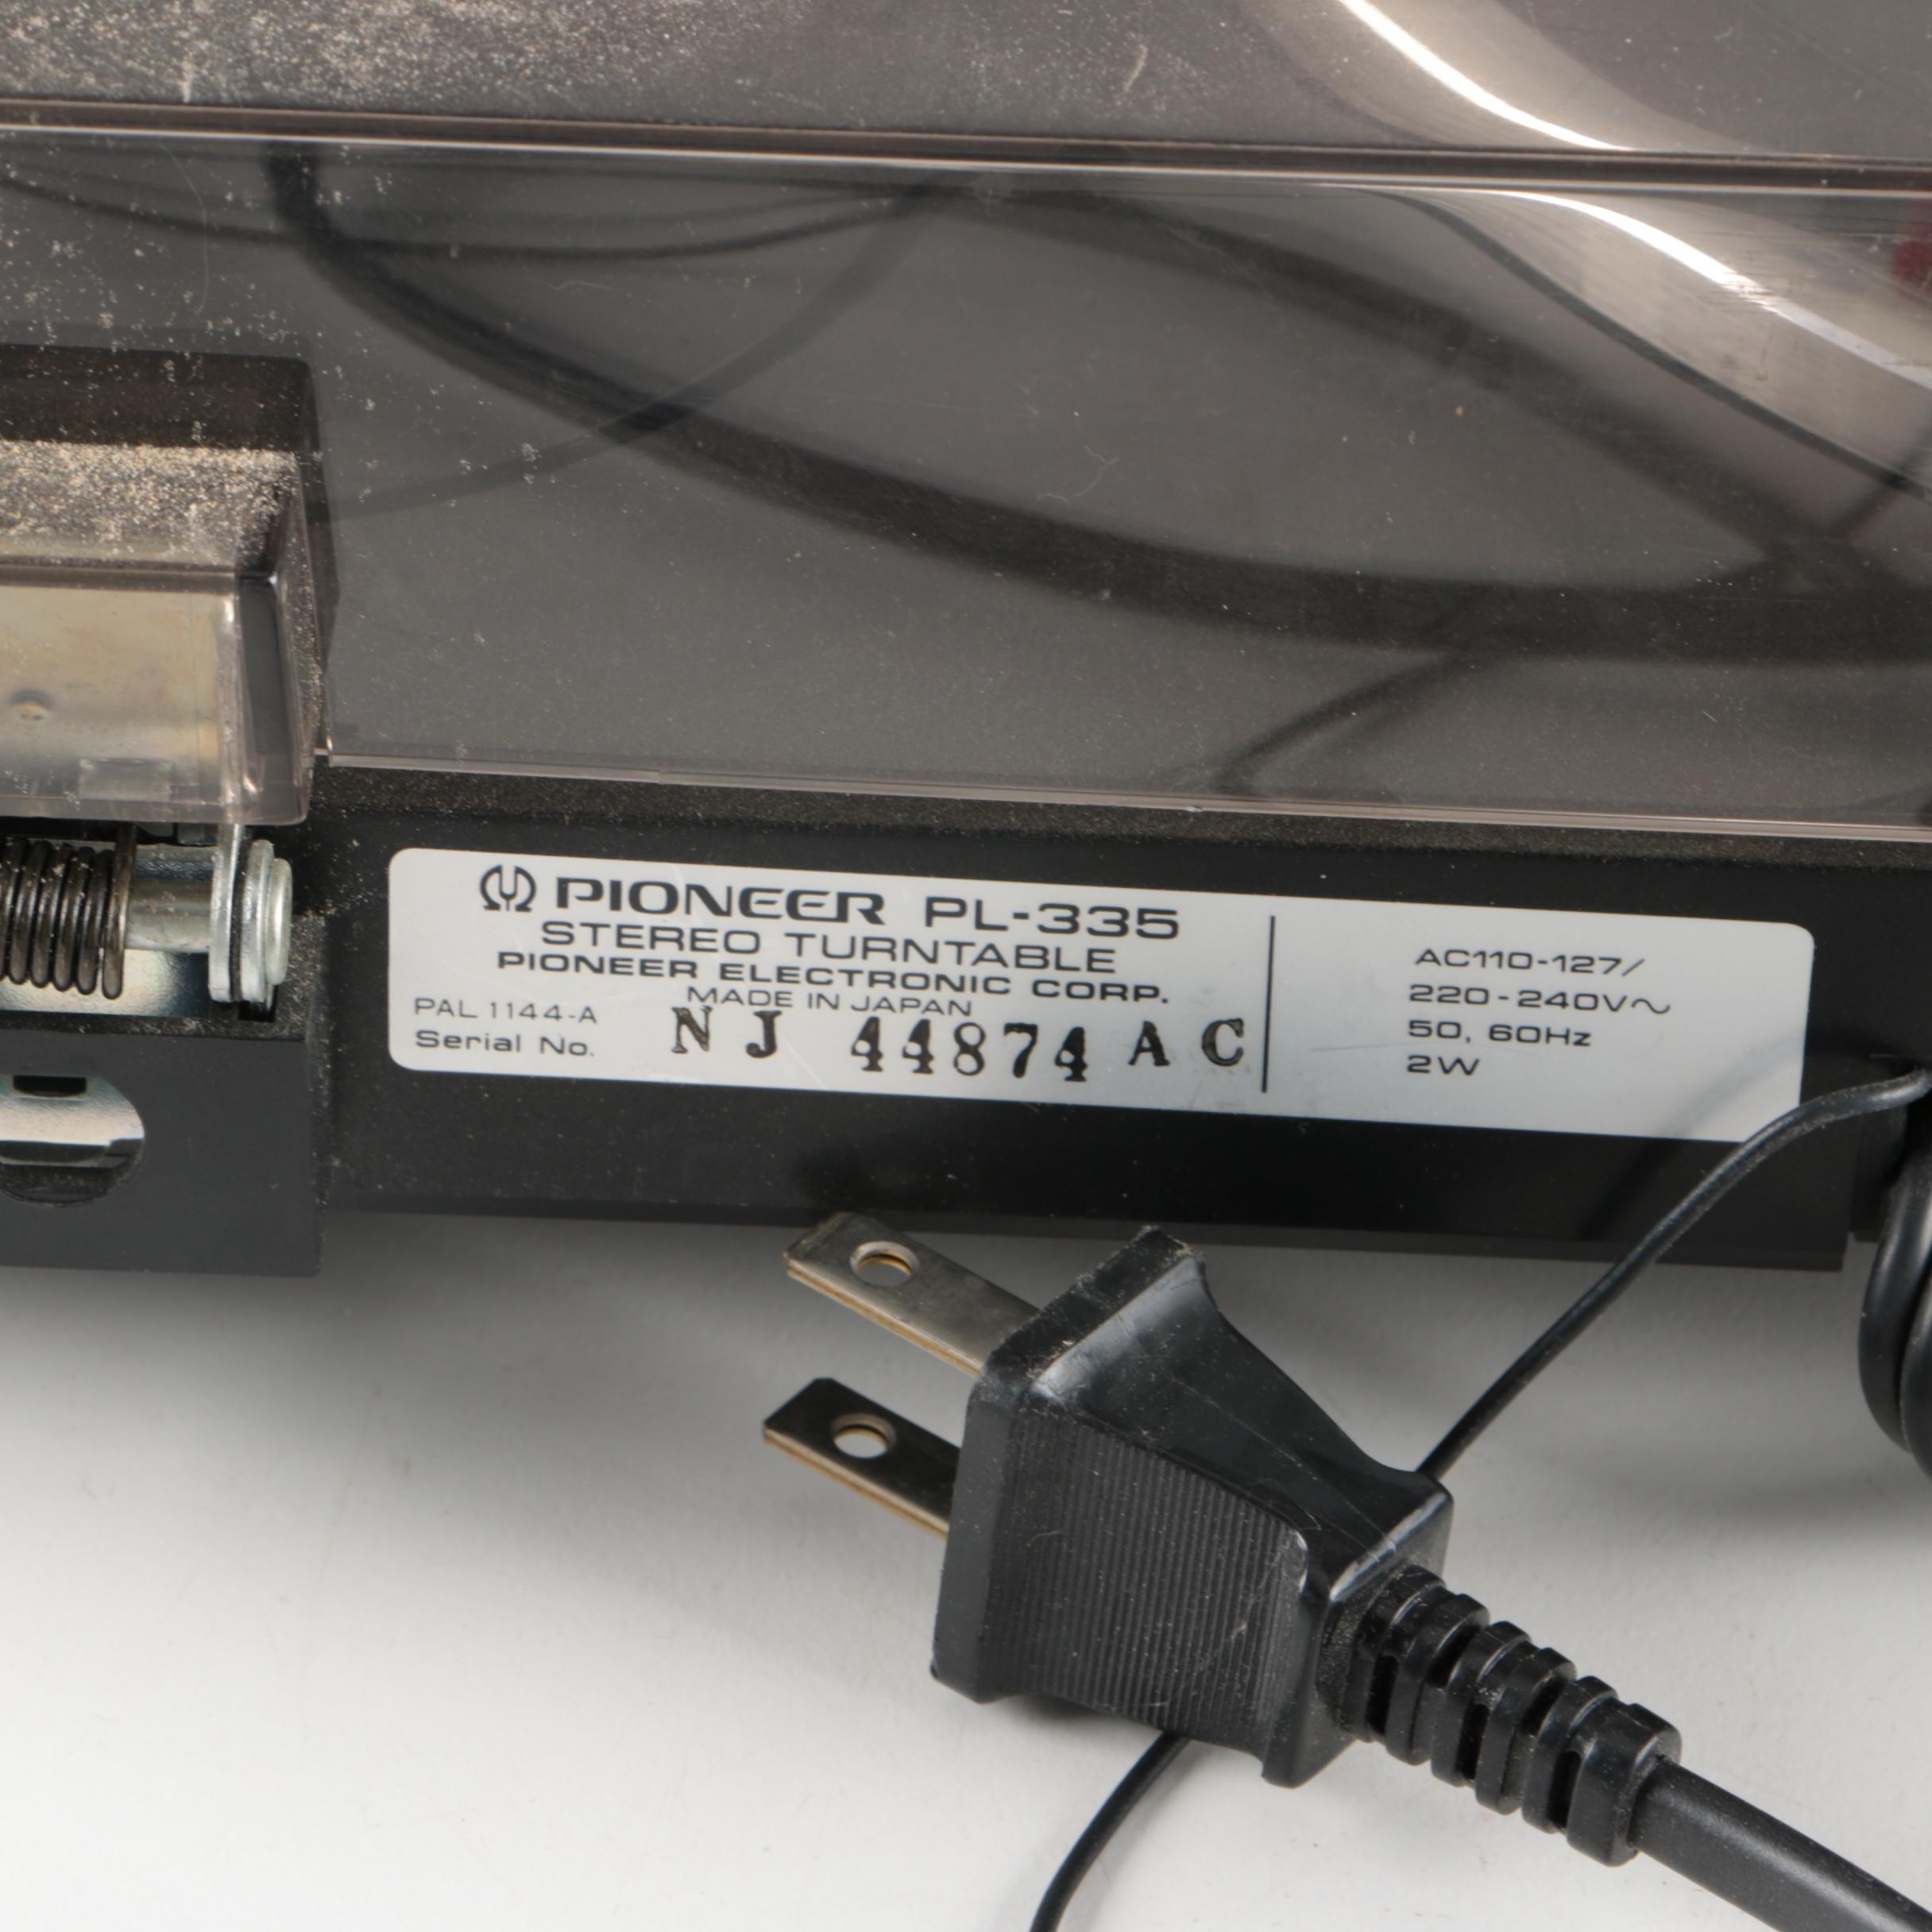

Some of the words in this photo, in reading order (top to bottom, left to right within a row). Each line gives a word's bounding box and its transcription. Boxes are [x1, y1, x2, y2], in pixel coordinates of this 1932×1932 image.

[556, 876, 886, 925] PIONEER
[925, 895, 1180, 940] PL-335
[541, 920, 761, 955] STEREO
[784, 931, 1116, 974] TURNTABLE
[497, 951, 698, 979] PIONEER
[719, 963, 1012, 995] ELECTRONIC
[1032, 979, 1169, 1004] CORP.
[686, 986, 794, 1009] MADE
[807, 992, 840, 1010] IN
[850, 993, 972, 1017] JAPAN
[415, 1030, 521, 1053] Serial
[539, 1036, 596, 1057] No.
[850, 1016, 1088, 1083] 44874
[1488, 1024, 1592, 1047] 60Hz
[1406, 1055, 1481, 1076] 2W
